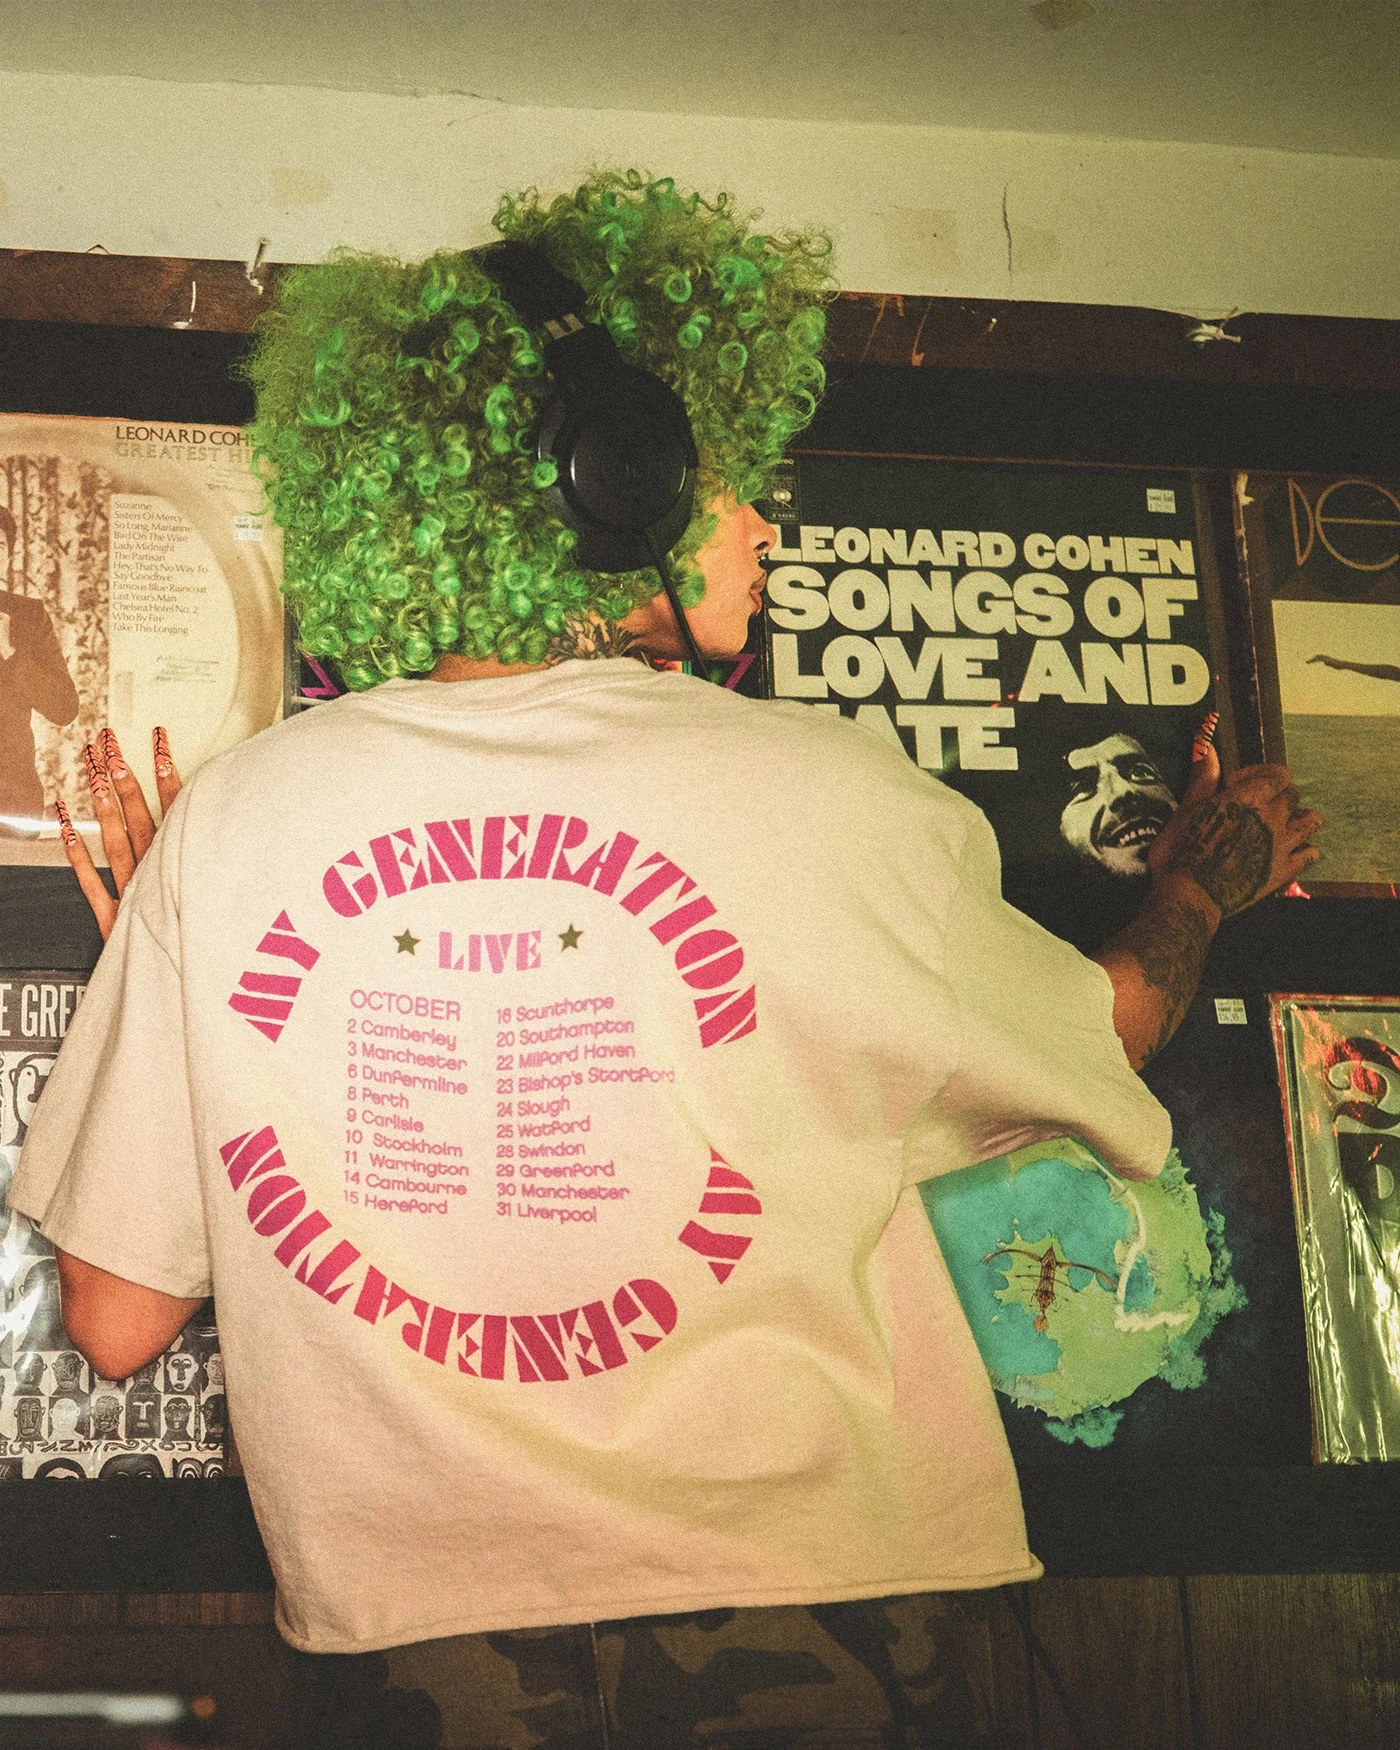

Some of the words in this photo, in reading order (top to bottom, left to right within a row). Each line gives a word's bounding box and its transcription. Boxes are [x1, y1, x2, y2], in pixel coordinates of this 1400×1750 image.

[116, 425, 206, 444] LEONARD
[116, 442, 221, 462] GREATEST
[114, 521, 125, 529] So
[142, 512, 154, 521] Of
[132, 532, 147, 541] On
[769, 523, 1016, 568] LEONARD
[1023, 533, 1196, 575] COHEN
[767, 565, 1075, 637] SONGS
[1084, 576, 1199, 640] OF
[772, 633, 1001, 700] LOVE
[1018, 639, 1210, 706] AND
[228, 909, 321, 1043] MY
[321, 813, 757, 1049] GENERATION
[437, 929, 543, 974] LIVE
[349, 989, 461, 1022] OCTOBER
[516, 995, 615, 1023] Scunthorpe
[347, 1018, 357, 1034] 2
[361, 1019, 457, 1052] Camberley
[496, 1030, 515, 1048] 20
[519, 1019, 635, 1045] Southampton
[347, 1041, 357, 1057] 3
[361, 1042, 468, 1071] Manchester
[496, 1054, 514, 1071] 22
[519, 1046, 579, 1069] Milford
[584, 1043, 636, 1059] Haven
[347, 1063, 358, 1079] 6
[361, 1064, 468, 1095] Dunfermline
[496, 1077, 514, 1095] 23
[518, 1070, 584, 1092] Bishop's
[347, 1085, 357, 1101] 8
[361, 1087, 409, 1109] Perth
[497, 1101, 513, 1118] 24
[517, 1095, 570, 1117] Slough
[346, 1107, 357, 1122] 9
[361, 1109, 424, 1133] Carlisle
[496, 1123, 514, 1139] 25
[517, 1115, 592, 1137] Watford
[345, 1128, 363, 1144] 10
[373, 1132, 463, 1157] Stockholm
[518, 1141, 586, 1159] Swindon
[344, 1150, 358, 1164] 11
[369, 1152, 469, 1178] Warrington
[496, 1163, 515, 1178] 29
[519, 1159, 616, 1178] Greenford
[344, 1169, 361, 1185] 14
[364, 1173, 468, 1196] Cambourne
[496, 1182, 517, 1197] 30
[520, 1183, 630, 1200] Manchester
[343, 1189, 360, 1205] 15
[364, 1193, 448, 1215] Hereford
[496, 1201, 512, 1216] 31
[517, 1203, 598, 1224] Liverpool
[218, 1124, 679, 1383] GENERATION
